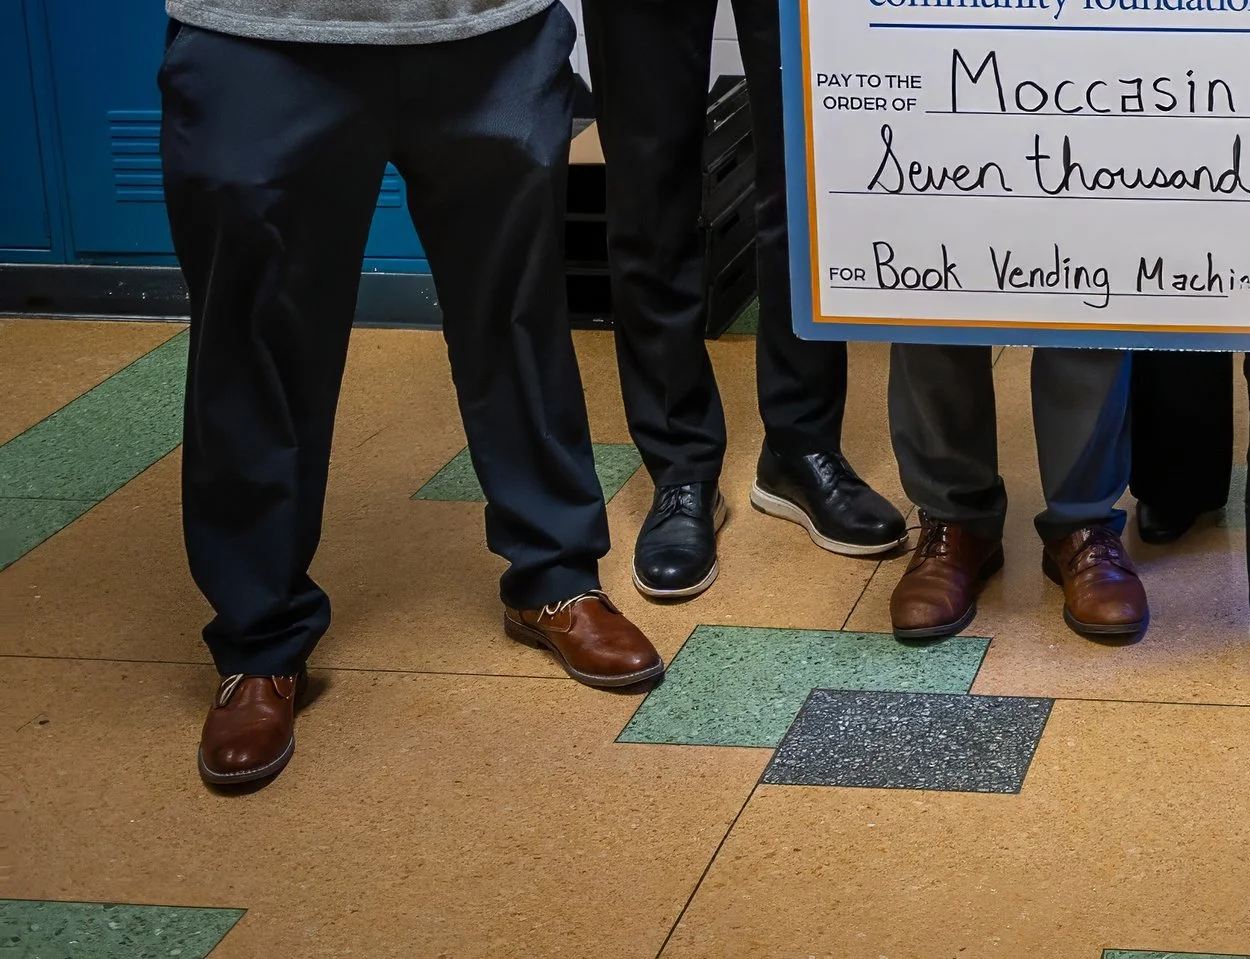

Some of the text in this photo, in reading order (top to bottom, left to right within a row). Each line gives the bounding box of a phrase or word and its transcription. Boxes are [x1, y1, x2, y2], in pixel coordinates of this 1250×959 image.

[817, 73, 922, 89] PAY TO THE
[952, 48, 1235, 114] Moccasin
[823, 95, 917, 111] ORDER OF
[868, 124, 1013, 195] Seven
[1025, 133, 1250, 195] thousand
[829, 266, 866, 282] FOR
[872, 240, 962, 291] Book
[989, 243, 1110, 308] Vending
